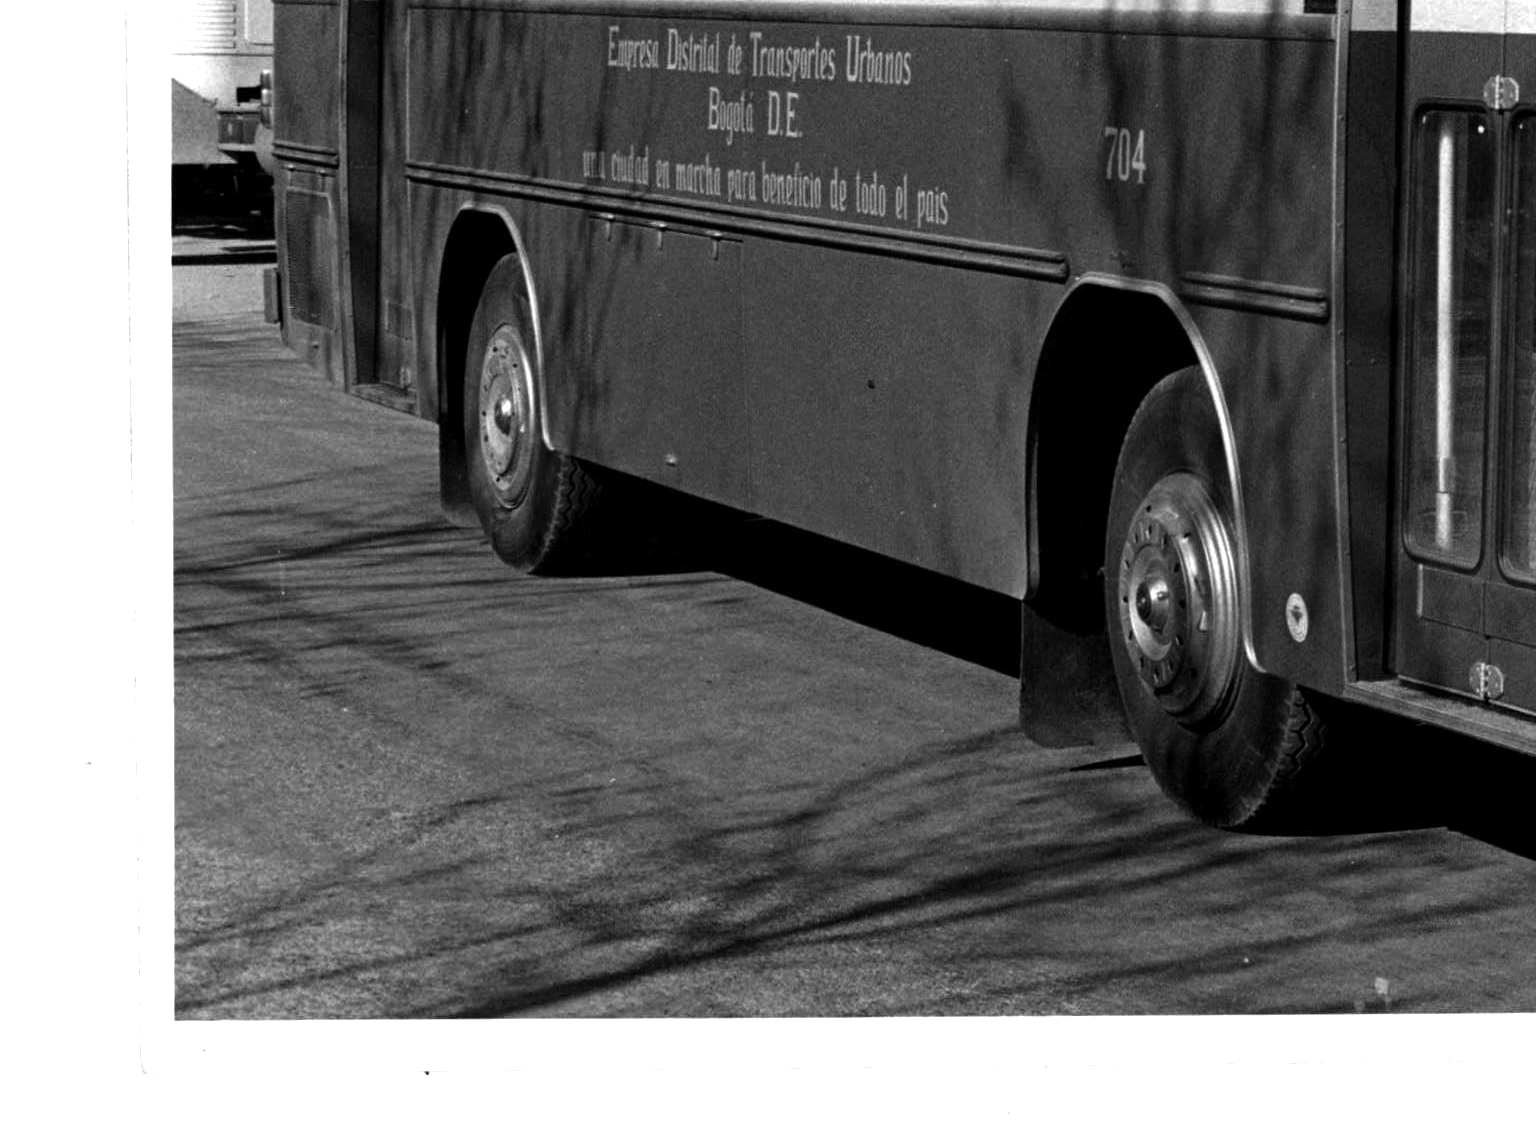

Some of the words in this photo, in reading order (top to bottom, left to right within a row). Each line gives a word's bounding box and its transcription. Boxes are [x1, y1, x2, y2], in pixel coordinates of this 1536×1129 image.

[608, 25, 659, 70] Empresa
[666, 27, 720, 74] Distrital
[727, 32, 743, 75] de
[750, 31, 836, 83] Transportes
[846, 35, 912, 86] Urbanos
[767, 90, 803, 138] D.E.
[611, 144, 649, 186] ciudad
[656, 159, 670, 190] en
[675, 153, 721, 196] marcha
[727, 169, 757, 205] para
[761, 160, 822, 209] beneficio
[830, 166, 847, 212] de
[855, 170, 886, 217] todo
[896, 172, 908, 220] el
[1105, 125, 1147, 184] 704
